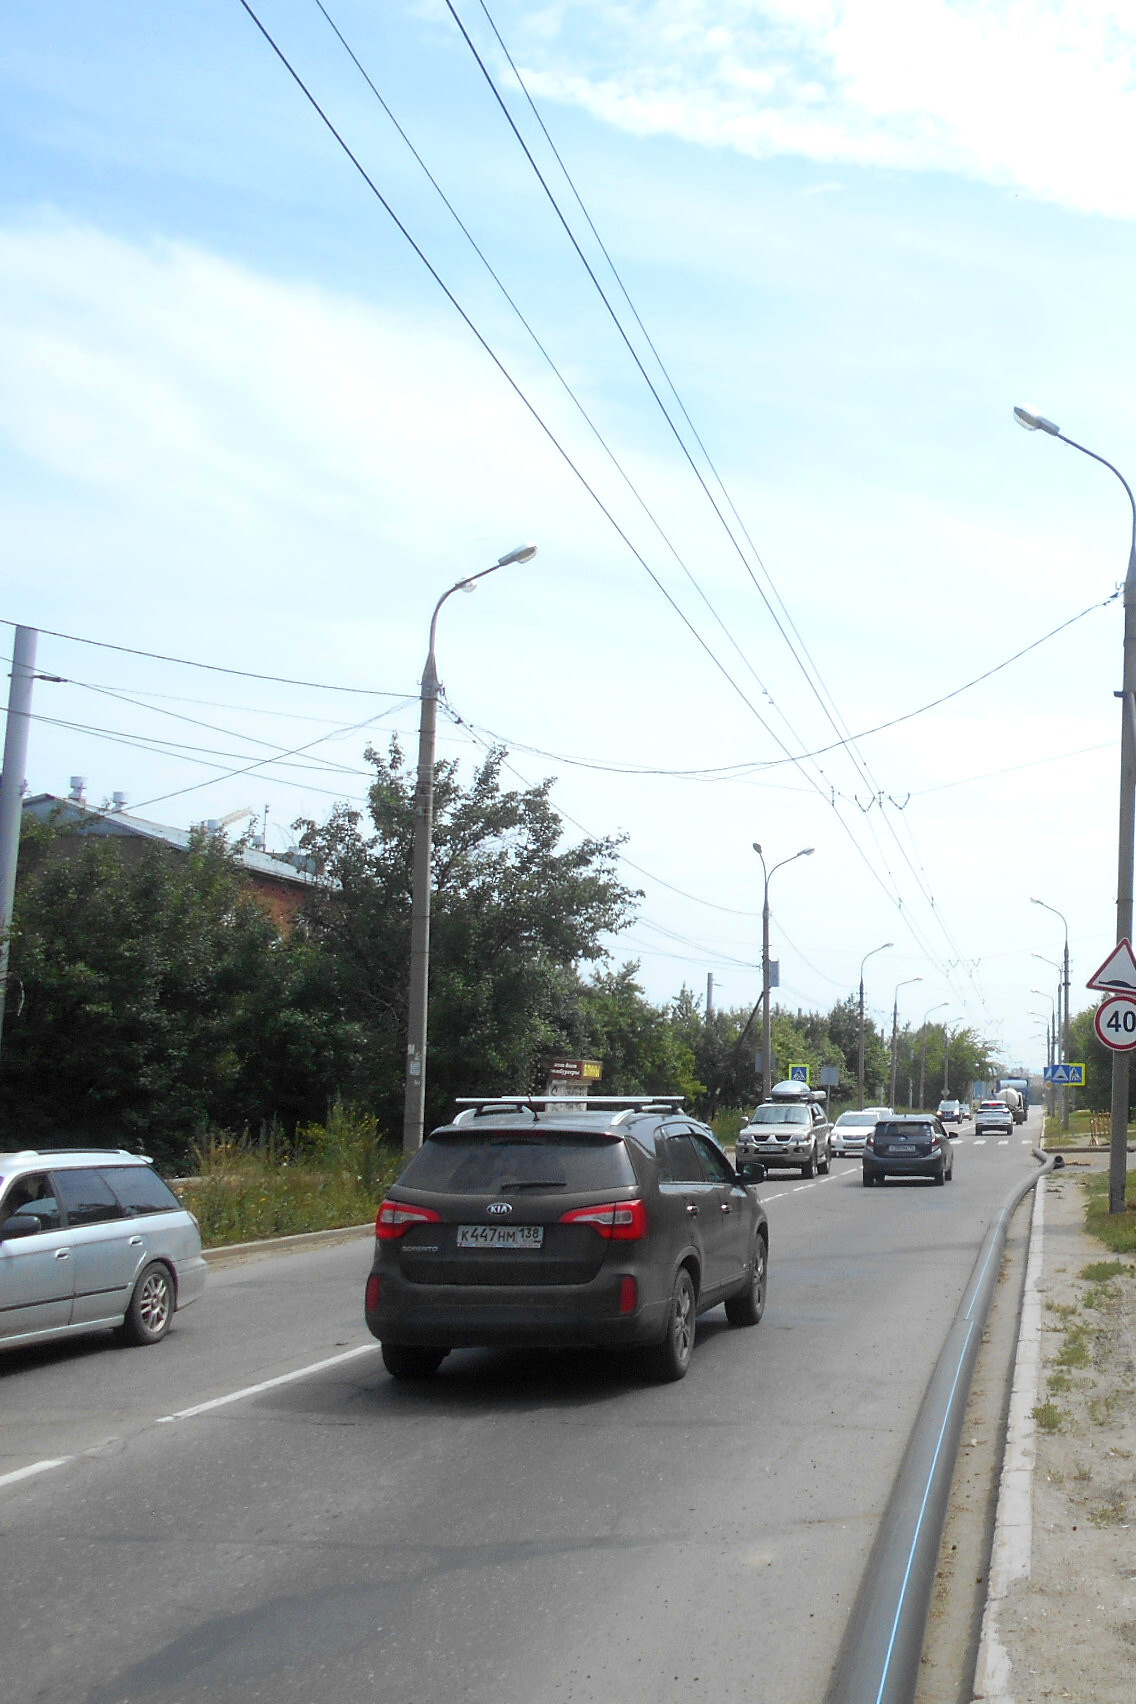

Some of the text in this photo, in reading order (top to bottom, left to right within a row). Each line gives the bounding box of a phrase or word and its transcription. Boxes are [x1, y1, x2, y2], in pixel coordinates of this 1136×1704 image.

[1106, 1010, 1136, 1033] 40
[489, 1205, 508, 1214] KIA
[518, 1227, 540, 1240] 138
